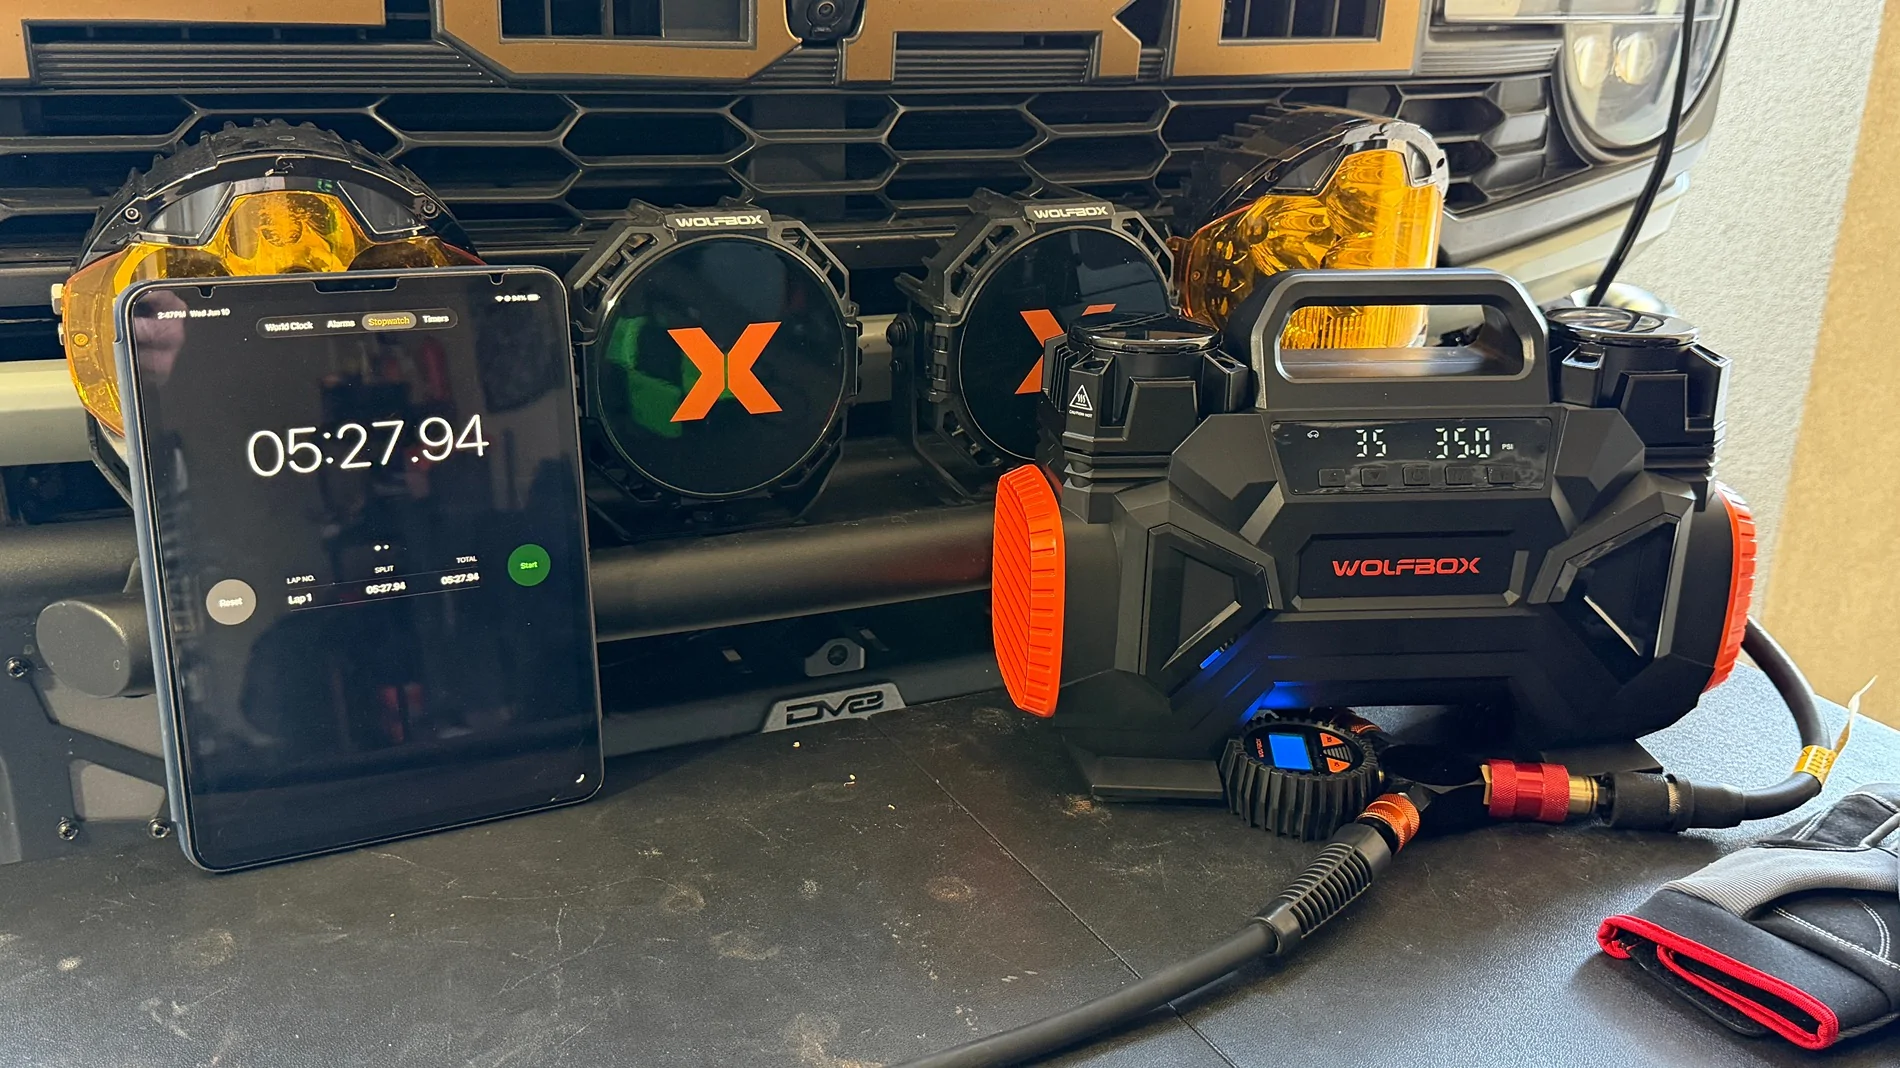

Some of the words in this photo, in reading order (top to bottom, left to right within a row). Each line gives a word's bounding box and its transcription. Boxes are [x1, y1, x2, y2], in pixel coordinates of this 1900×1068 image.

[1034, 206, 1108, 219] WOLFBOX
[675, 214, 764, 228] WOLFBOX
[327, 319, 355, 329] Alarms
[368, 316, 410, 327] Stopwatch
[422, 314, 449, 324] Timers
[265, 321, 290, 332] World
[290, 321, 313, 331] Clock
[247, 413, 490, 477] 05:27.94
[1356, 428, 1387, 458] 35
[1435, 427, 1491, 459] 35.0
[1502, 443, 1514, 451] PSI
[456, 555, 478, 564] TOTAL
[374, 565, 394, 574] SPLIT
[520, 561, 538, 570] Start
[1332, 557, 1481, 577] WOLFBOX
[286, 576, 301, 585] LAP
[301, 575, 315, 583] NO.
[218, 597, 243, 608] Reset
[288, 594, 306, 605] Lap
[306, 593, 313, 603] 1
